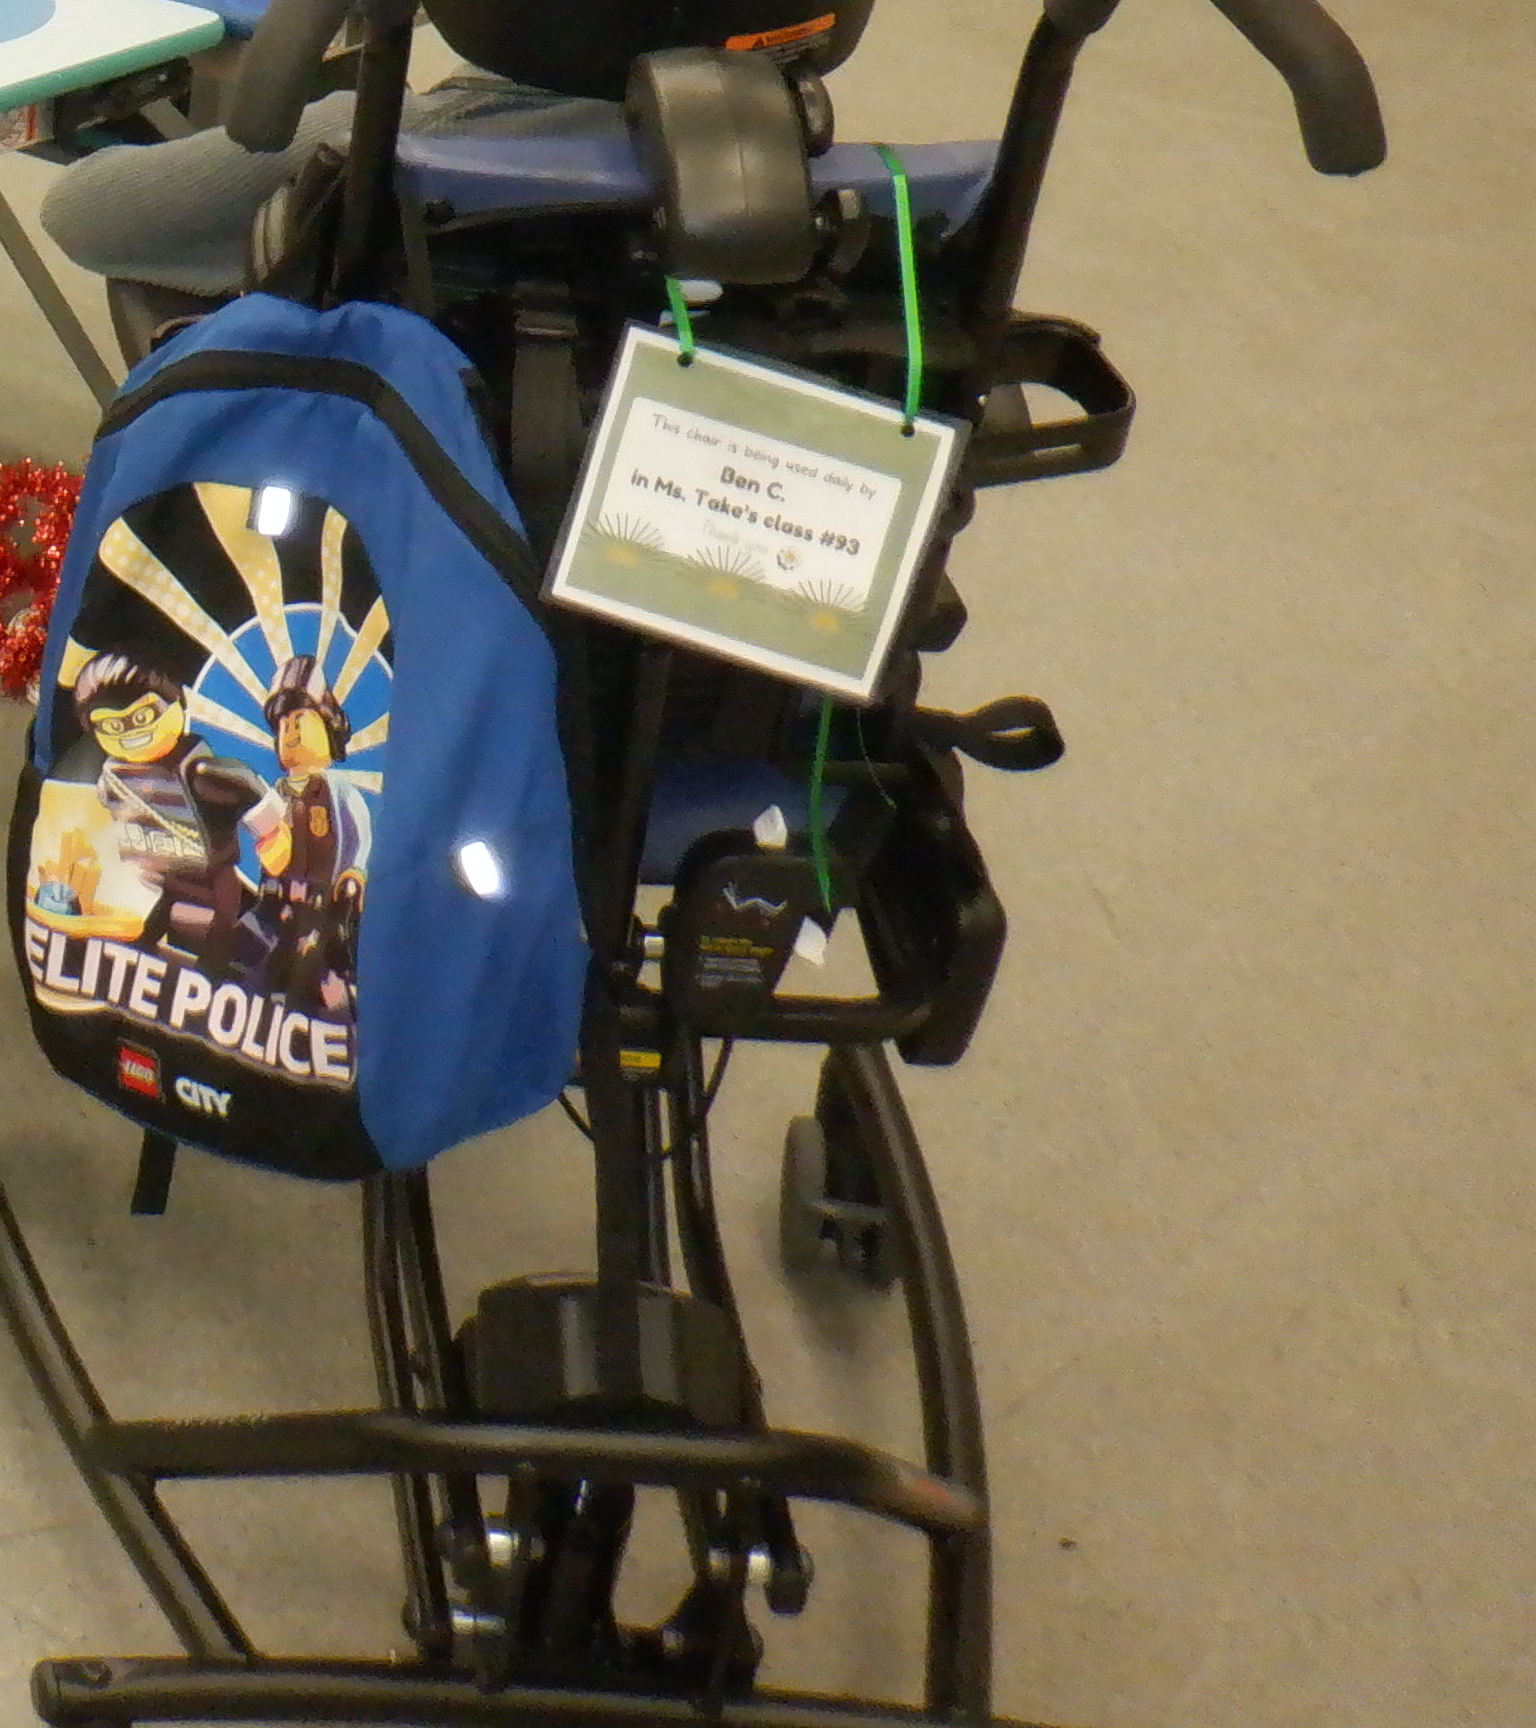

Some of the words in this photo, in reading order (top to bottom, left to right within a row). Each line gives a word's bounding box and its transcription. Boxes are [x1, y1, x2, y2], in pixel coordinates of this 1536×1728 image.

[652, 413, 680, 435] This
[686, 428, 721, 447] chair
[727, 441, 738, 454] is
[744, 445, 780, 469] being
[785, 459, 819, 478] used
[823, 471, 855, 494] daily
[859, 481, 877, 501] by
[766, 480, 786, 503] C.
[630, 467, 649, 489] in
[654, 475, 686, 502] Ms.
[763, 513, 814, 542] class
[819, 529, 861, 556] #93
[24, 916, 169, 1020] ELITE
[170, 966, 351, 1082] POLICE
[175, 1075, 233, 1118] CITY
